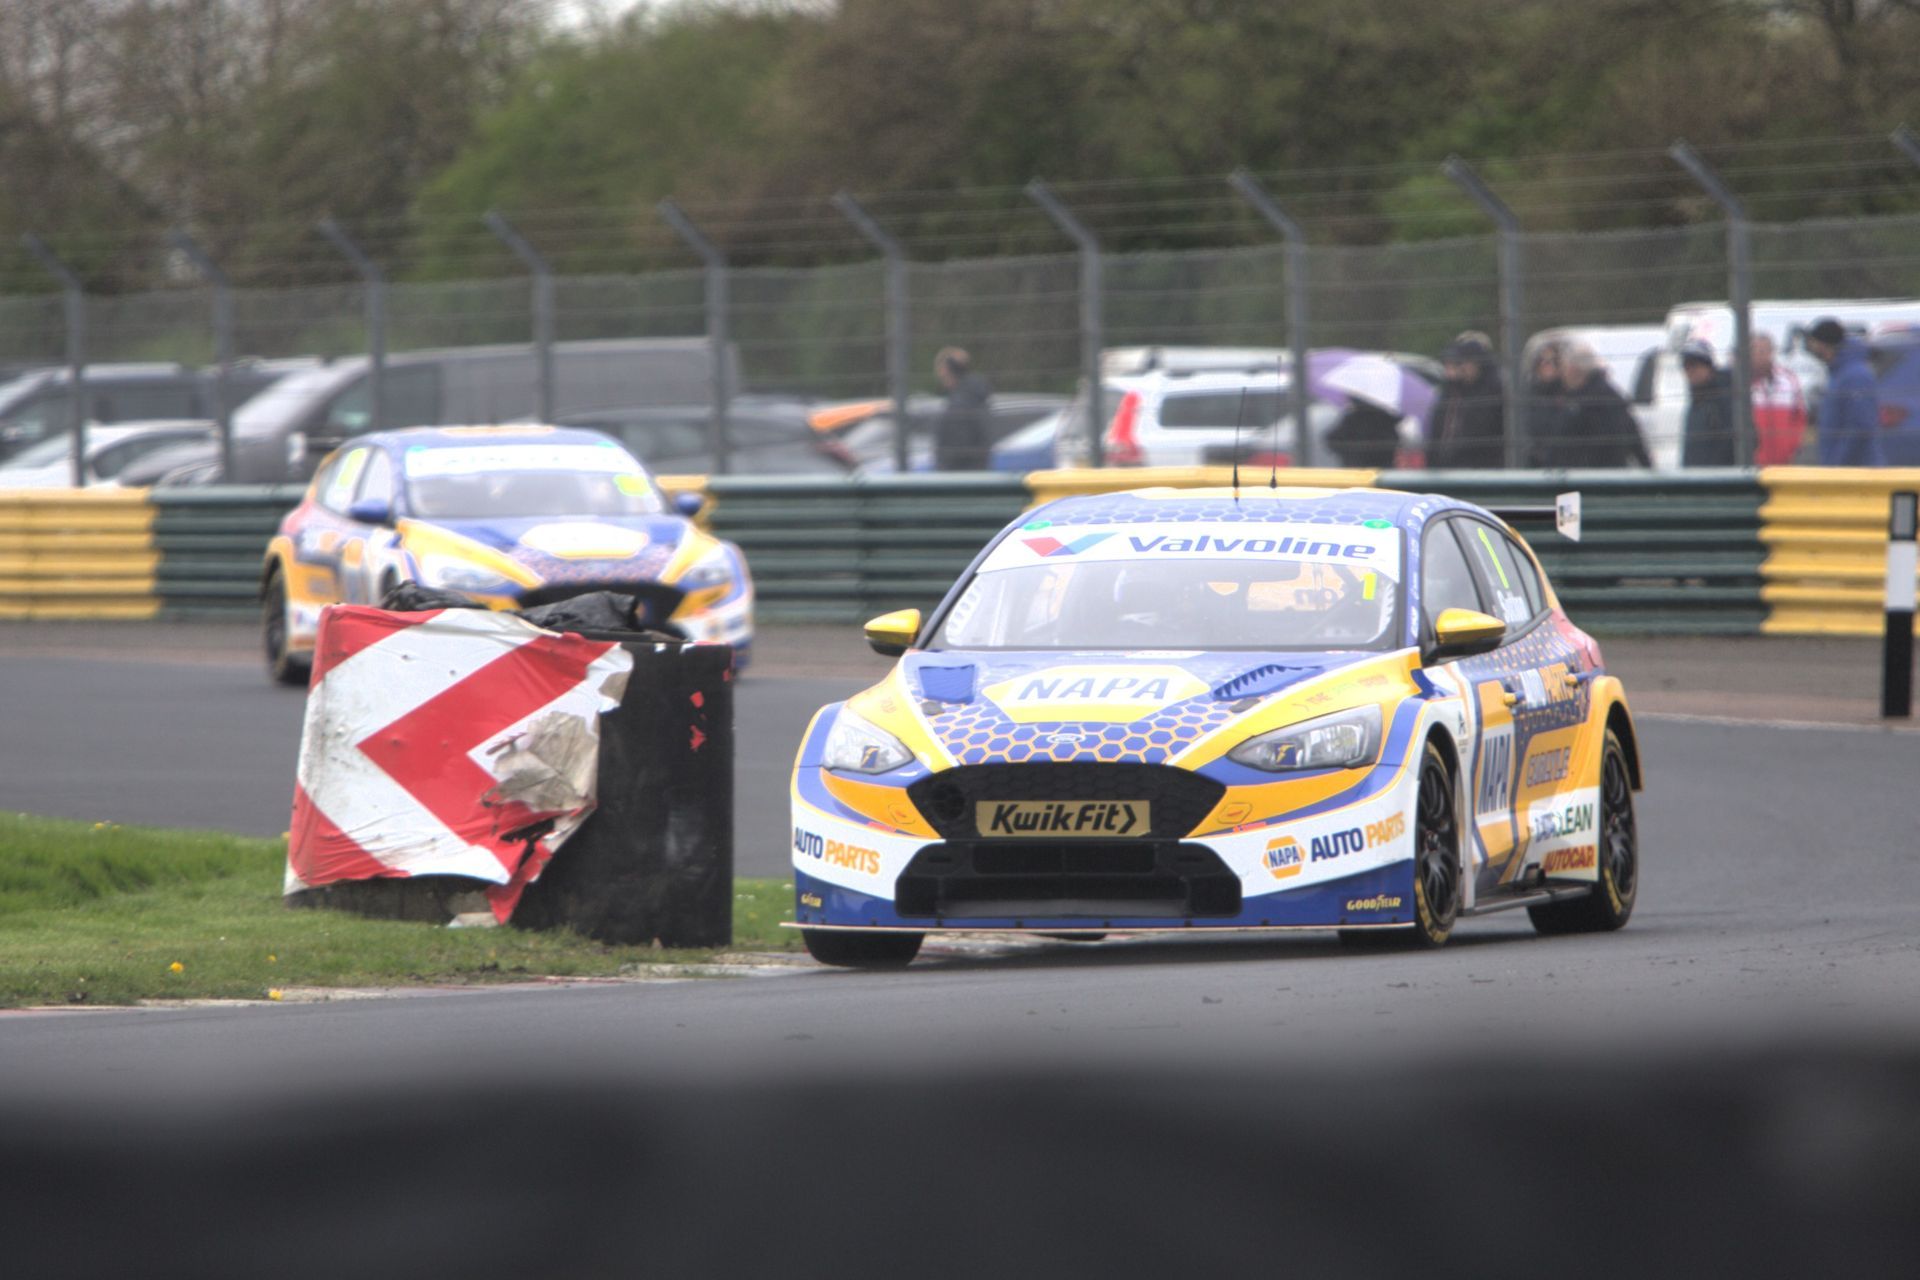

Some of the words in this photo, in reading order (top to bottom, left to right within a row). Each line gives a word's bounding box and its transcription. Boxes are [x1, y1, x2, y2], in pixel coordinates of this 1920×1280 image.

[1129, 535, 1376, 560] Valvoline
[1361, 572, 1378, 601] 1
[1017, 678, 1170, 700] NAPA
[1477, 734, 1511, 815] NAPA
[1268, 846, 1300, 868] NAPA
[1311, 828, 1364, 862] AUTO
[1365, 811, 1404, 848] PARTS
[825, 839, 880, 874] PARTS
[1543, 846, 1595, 872] AUTOCAR
